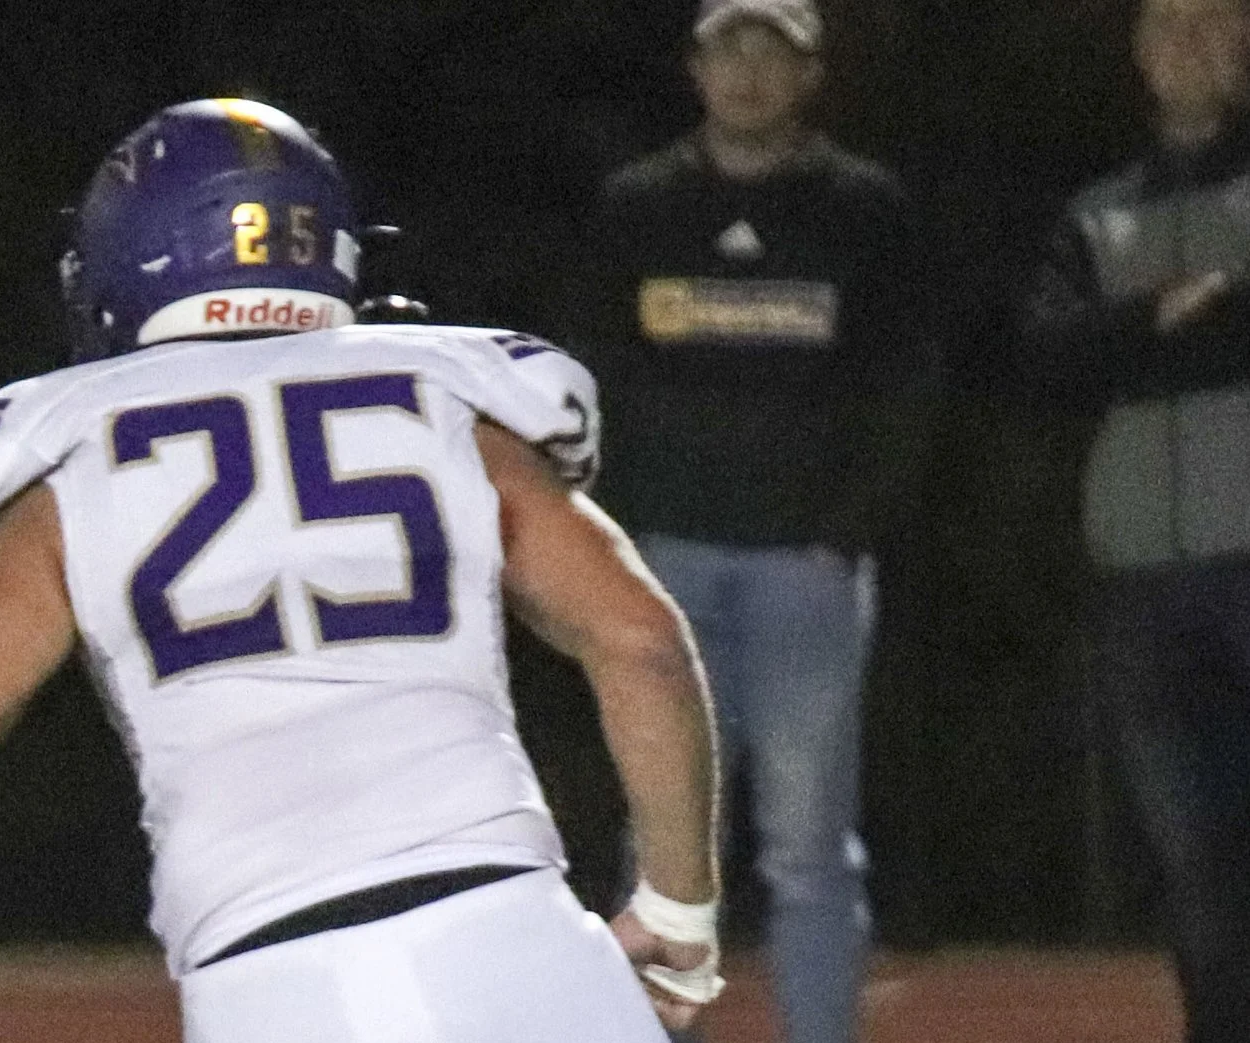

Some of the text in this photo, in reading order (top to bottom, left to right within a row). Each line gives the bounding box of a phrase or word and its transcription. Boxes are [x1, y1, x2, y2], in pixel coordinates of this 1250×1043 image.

[231, 202, 318, 265] 25
[205, 298, 334, 328] Riddell
[109, 372, 453, 683] 25
